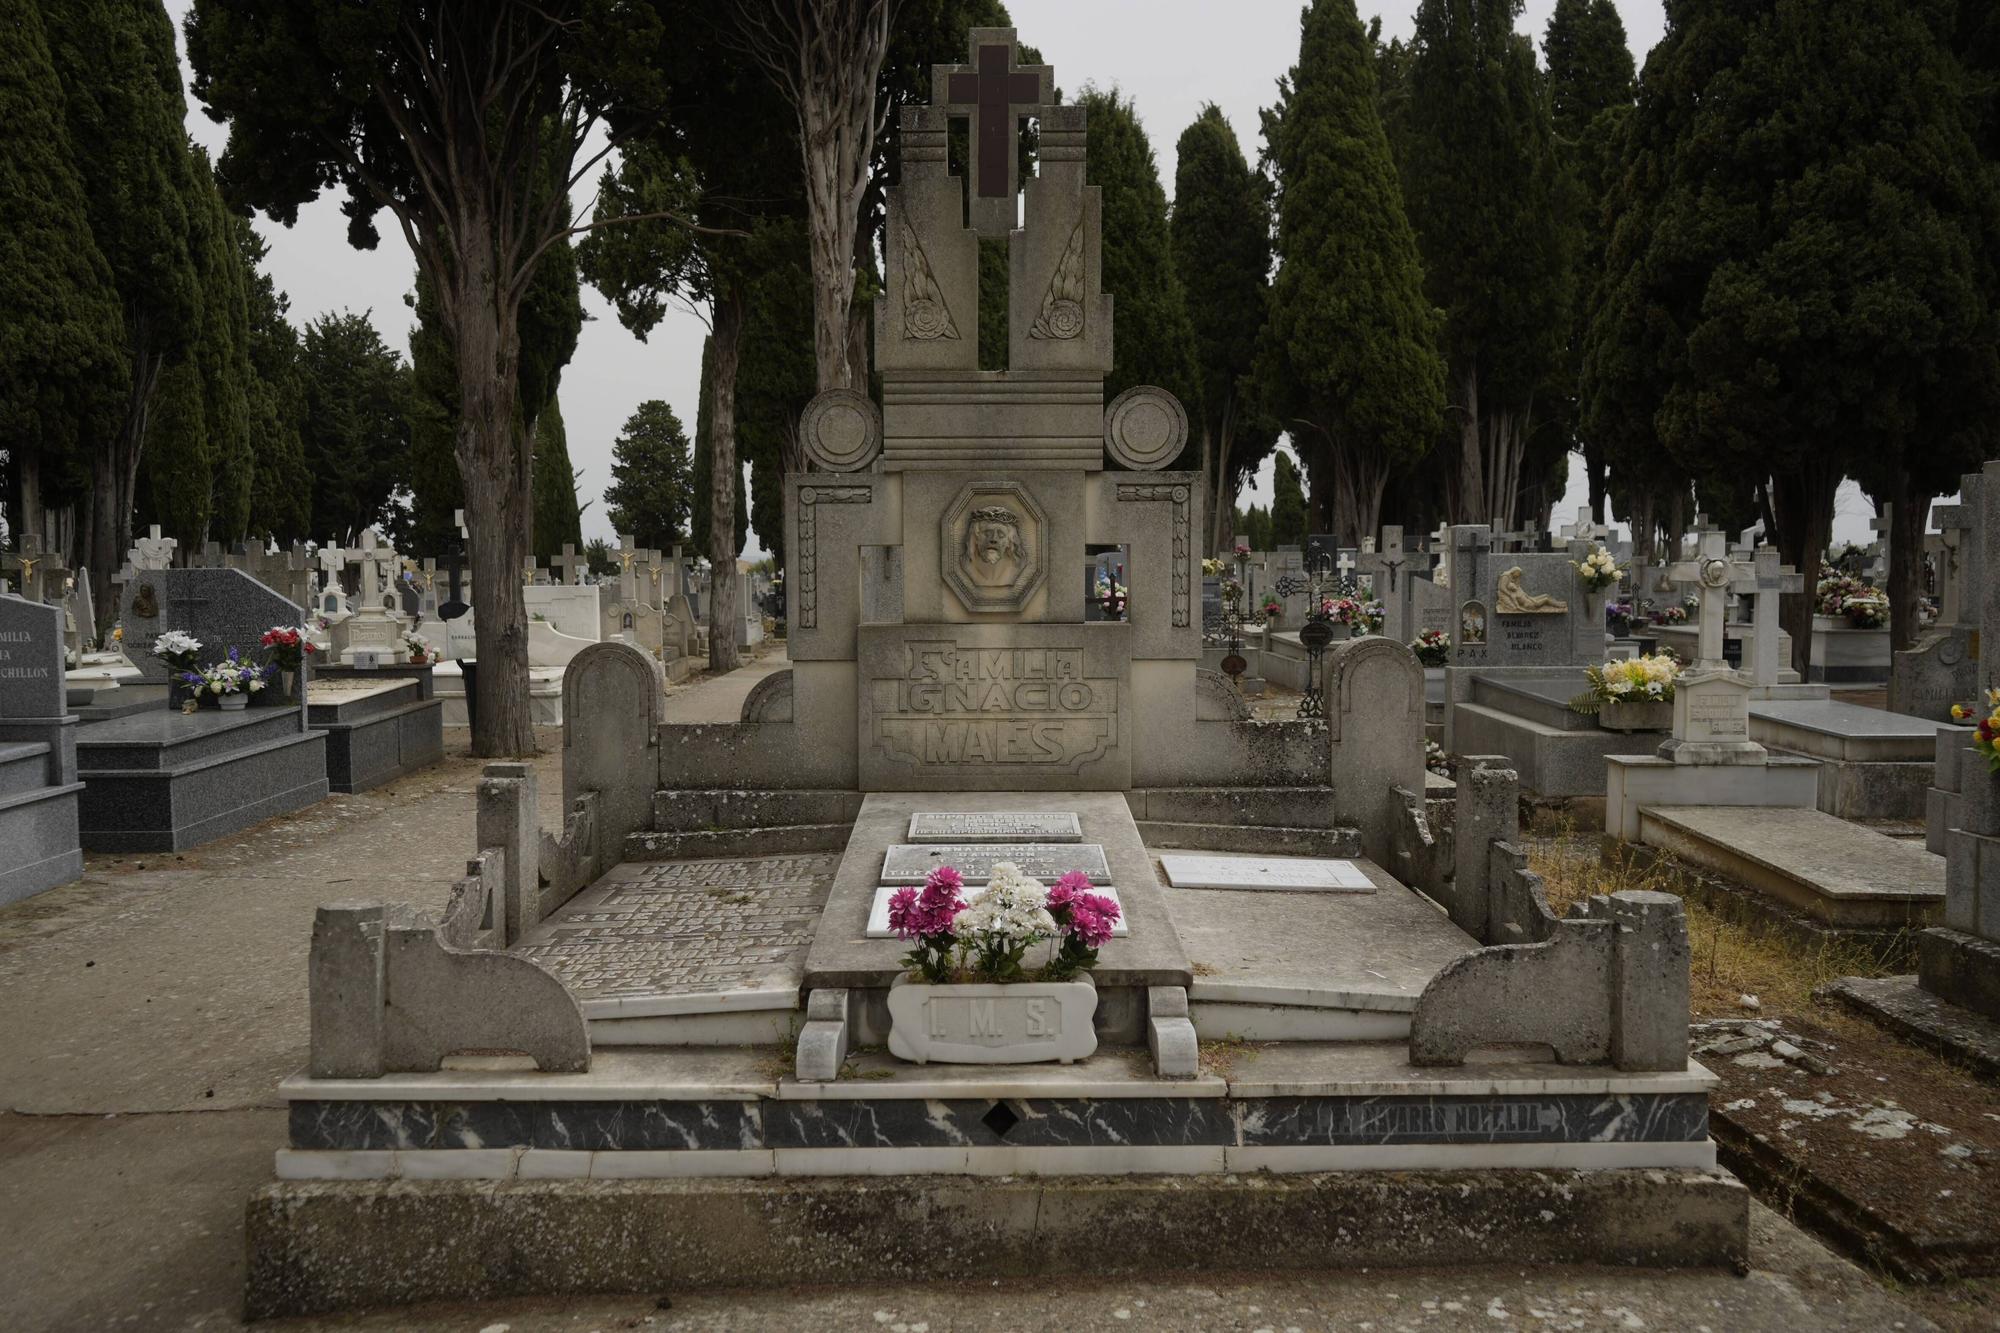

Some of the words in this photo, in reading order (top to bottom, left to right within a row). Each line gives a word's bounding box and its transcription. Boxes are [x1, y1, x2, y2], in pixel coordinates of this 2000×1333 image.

[909, 646, 1080, 681] FAMILIA
[898, 682, 1093, 714] IGNACIO
[925, 720, 1066, 764] MAES
